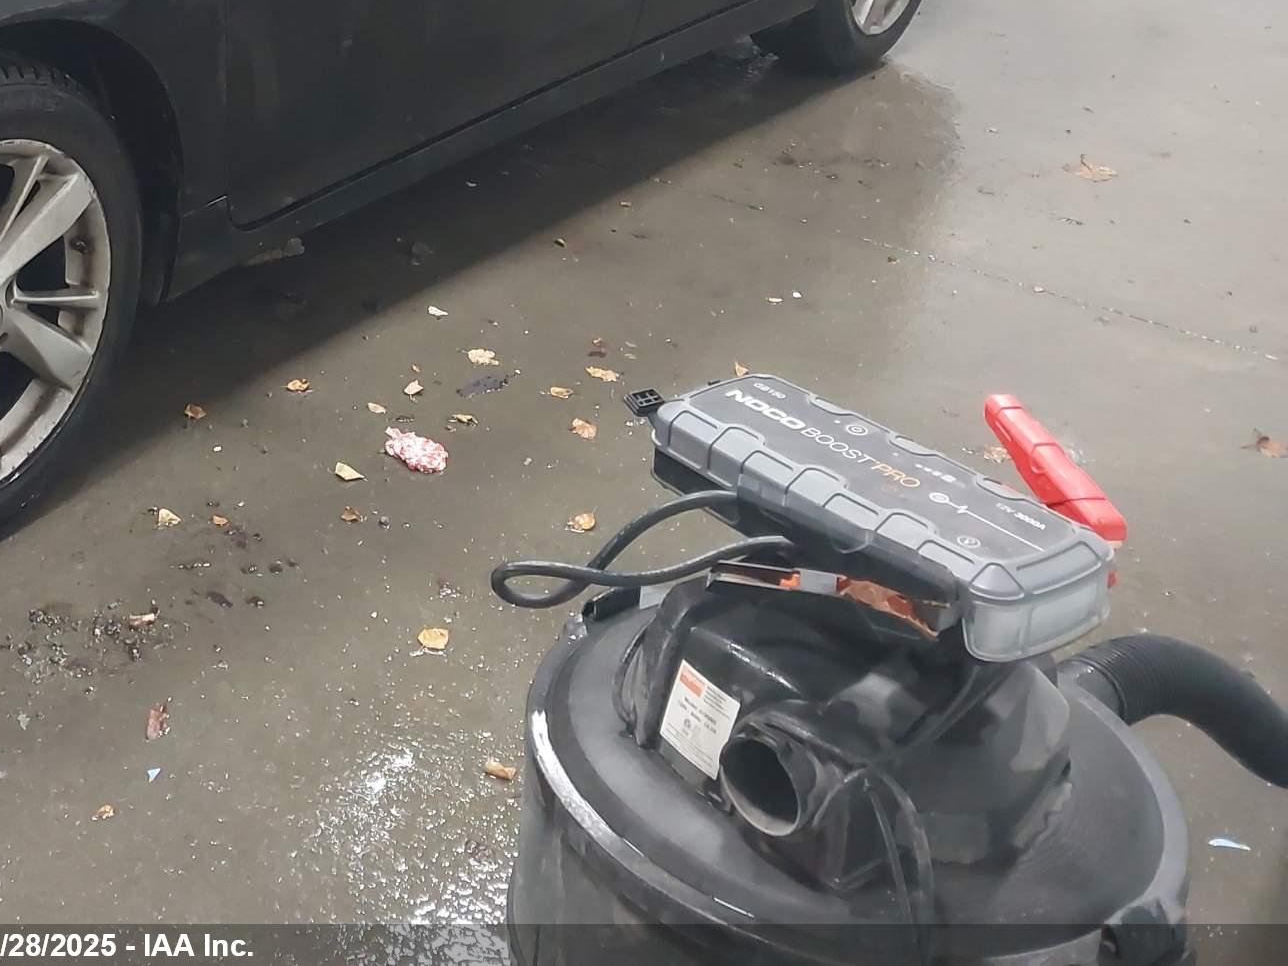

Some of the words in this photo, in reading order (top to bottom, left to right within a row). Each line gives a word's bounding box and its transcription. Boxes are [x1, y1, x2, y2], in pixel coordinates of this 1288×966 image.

[725, 389, 807, 430] NOCO
[800, 427, 876, 464] BOOST
[870, 461, 921, 488] PRO
[1014, 512, 1046, 530] 3000A
